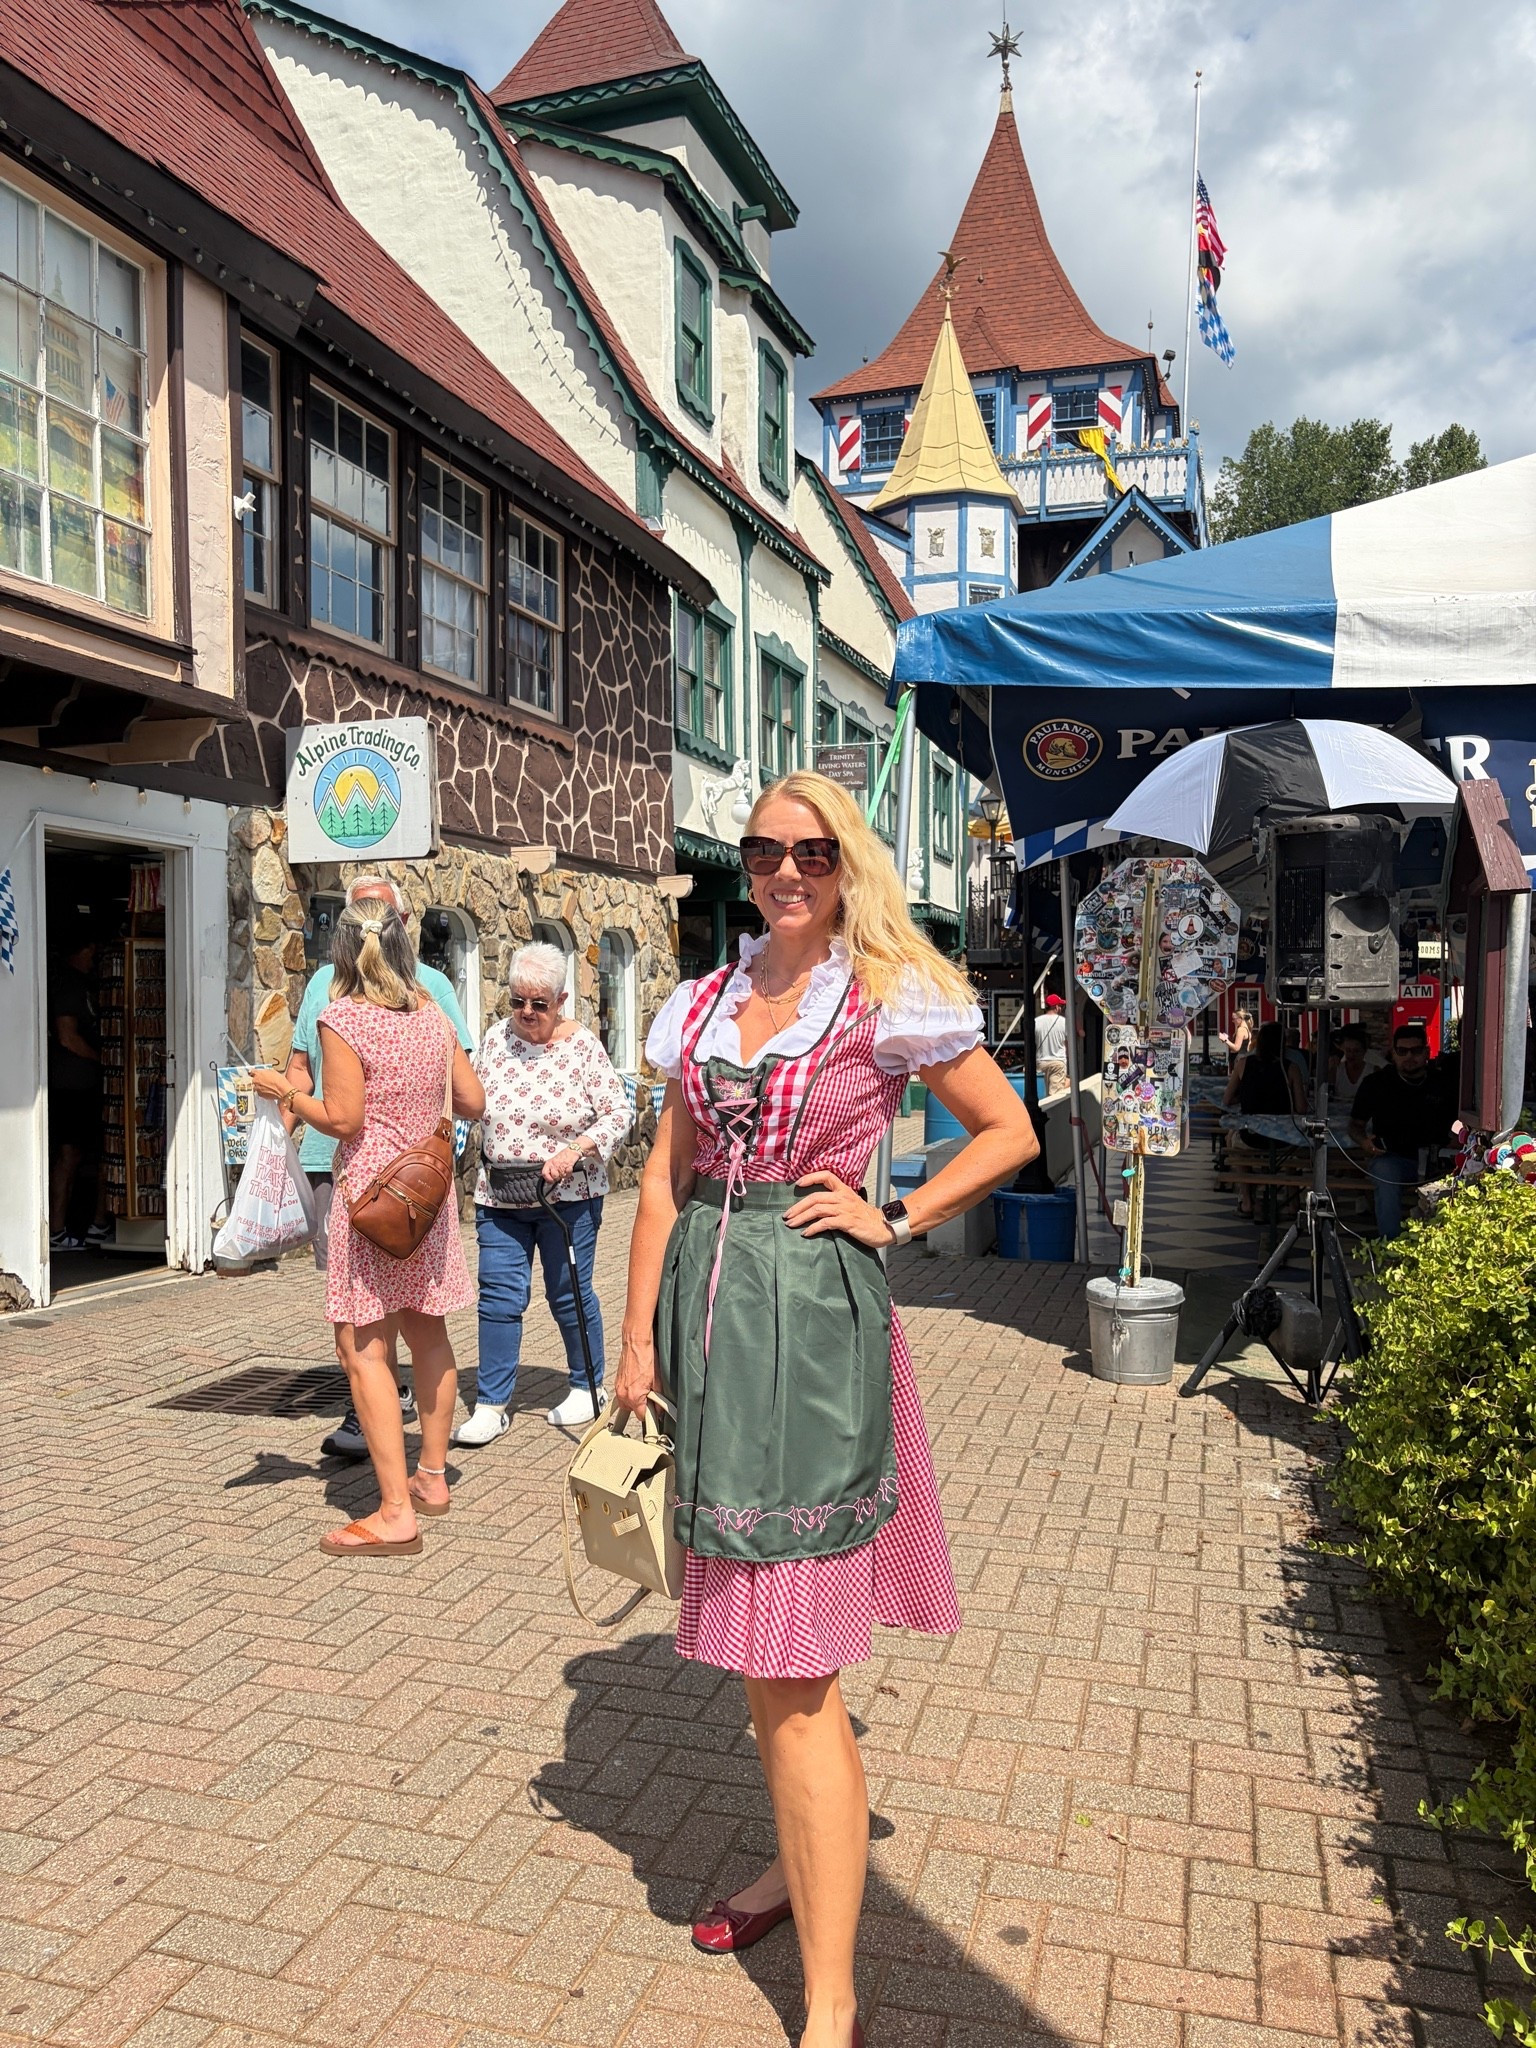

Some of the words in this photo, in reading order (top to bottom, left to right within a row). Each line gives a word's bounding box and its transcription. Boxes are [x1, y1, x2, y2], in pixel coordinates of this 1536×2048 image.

[1029, 722, 1095, 745] PAULANER
[296, 732, 348, 777] Alpine
[347, 726, 405, 762] Trading
[403, 744, 420, 771] Co.
[1419, 946, 1440, 954] OOMS
[1403, 986, 1432, 997] ATM
